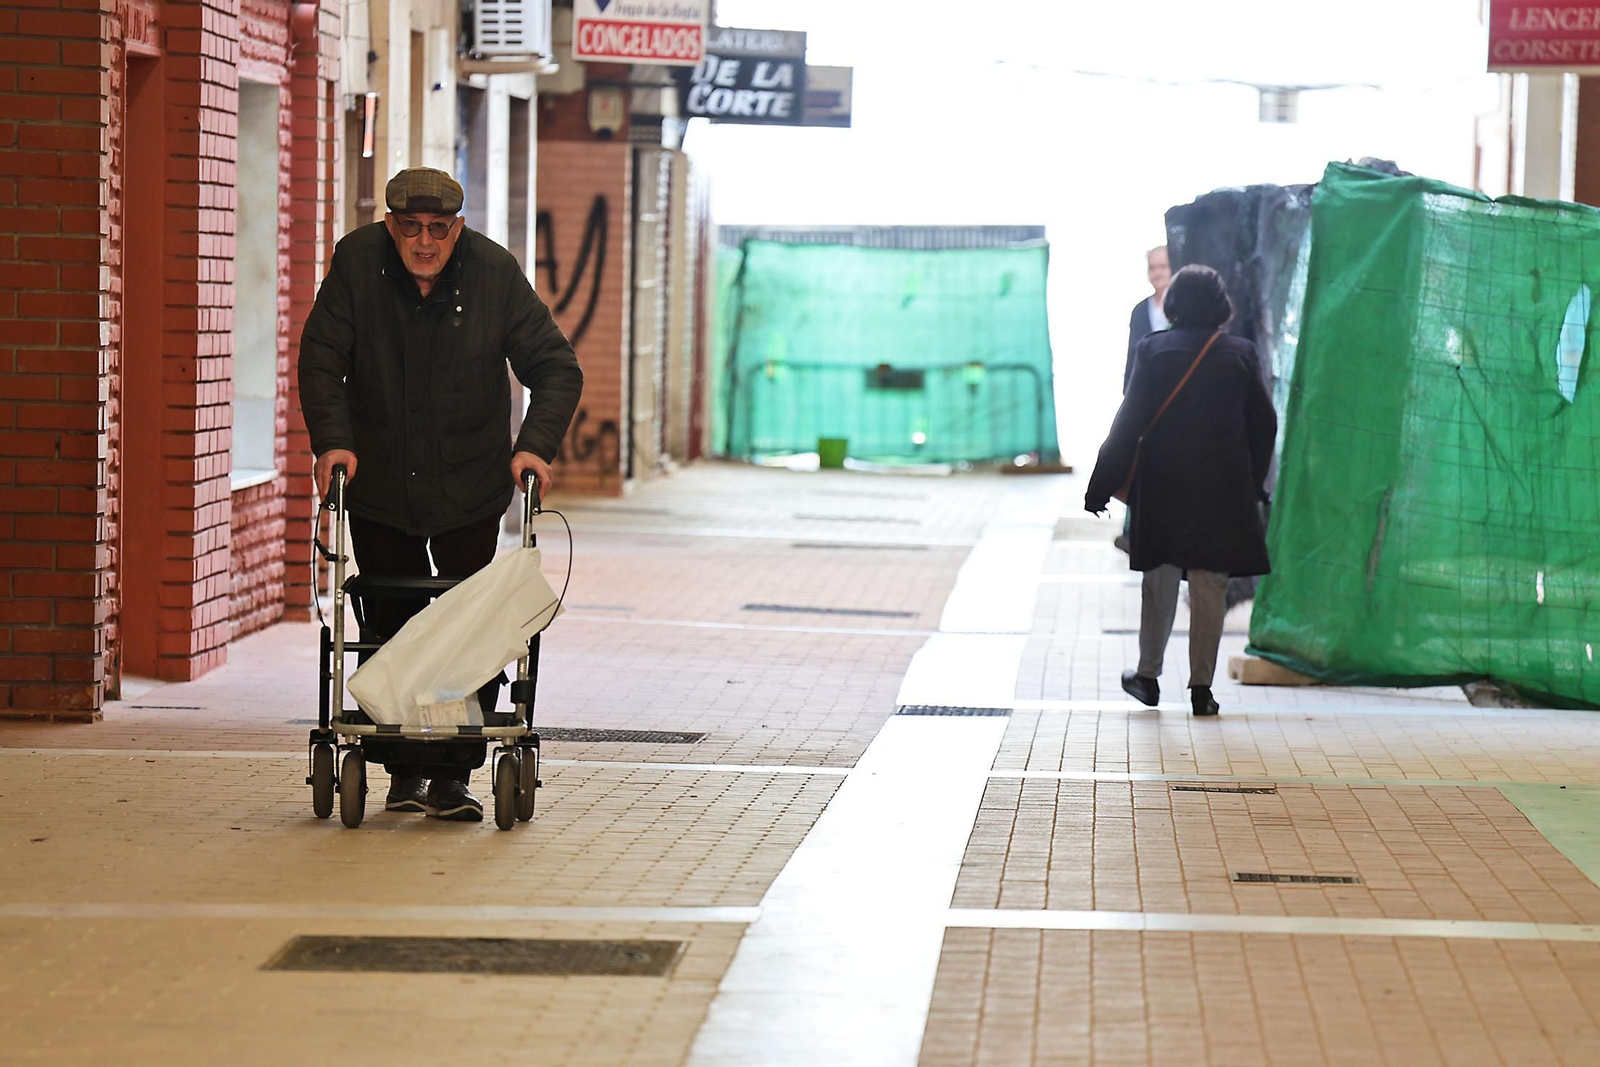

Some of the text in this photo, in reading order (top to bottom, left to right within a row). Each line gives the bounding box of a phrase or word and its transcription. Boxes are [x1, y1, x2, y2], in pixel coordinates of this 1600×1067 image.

[580, 23, 699, 58] CONGELADOS
[691, 55, 794, 88] DE LA
[687, 83, 795, 117] CORTE
